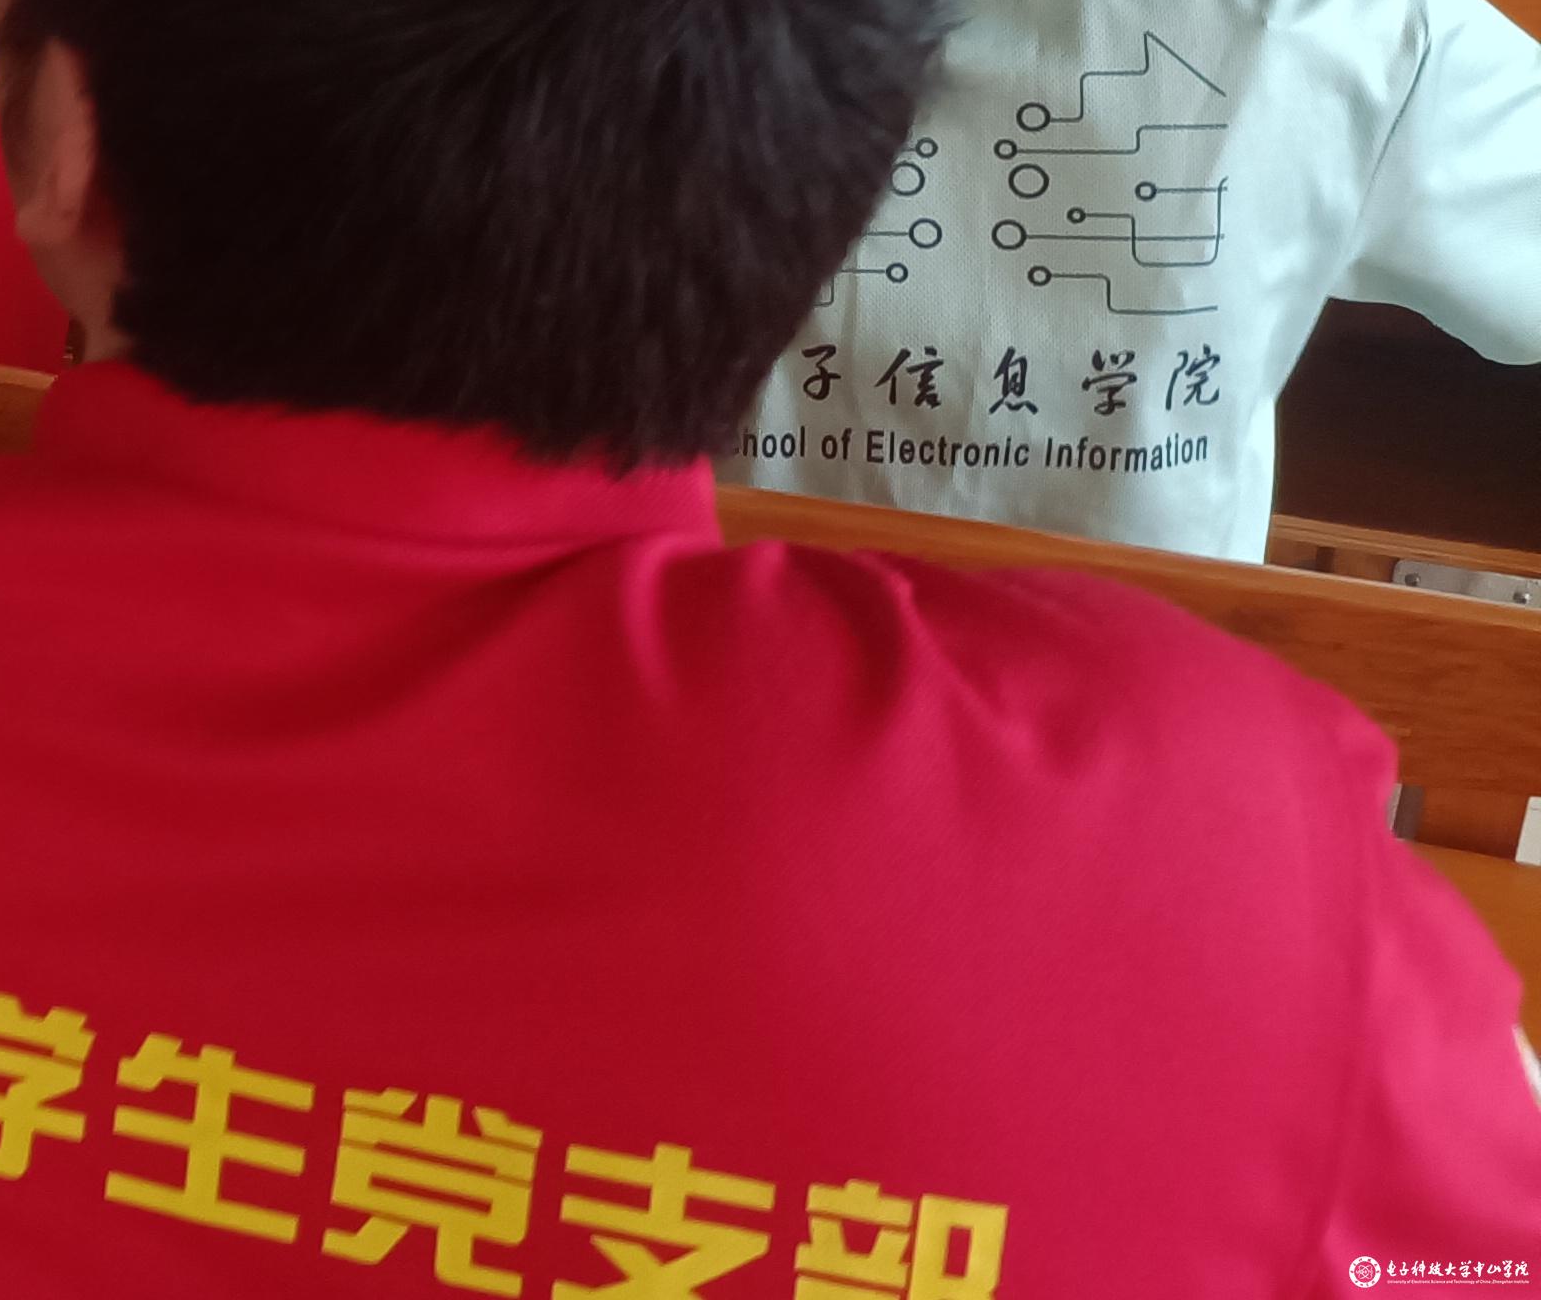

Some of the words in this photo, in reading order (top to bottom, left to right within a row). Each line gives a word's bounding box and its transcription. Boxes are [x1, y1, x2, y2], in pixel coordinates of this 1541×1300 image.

[734, 425, 805, 458] hool
[821, 427, 852, 460] of
[866, 429, 1030, 467] Electronic
[1045, 433, 1209, 473] Information
